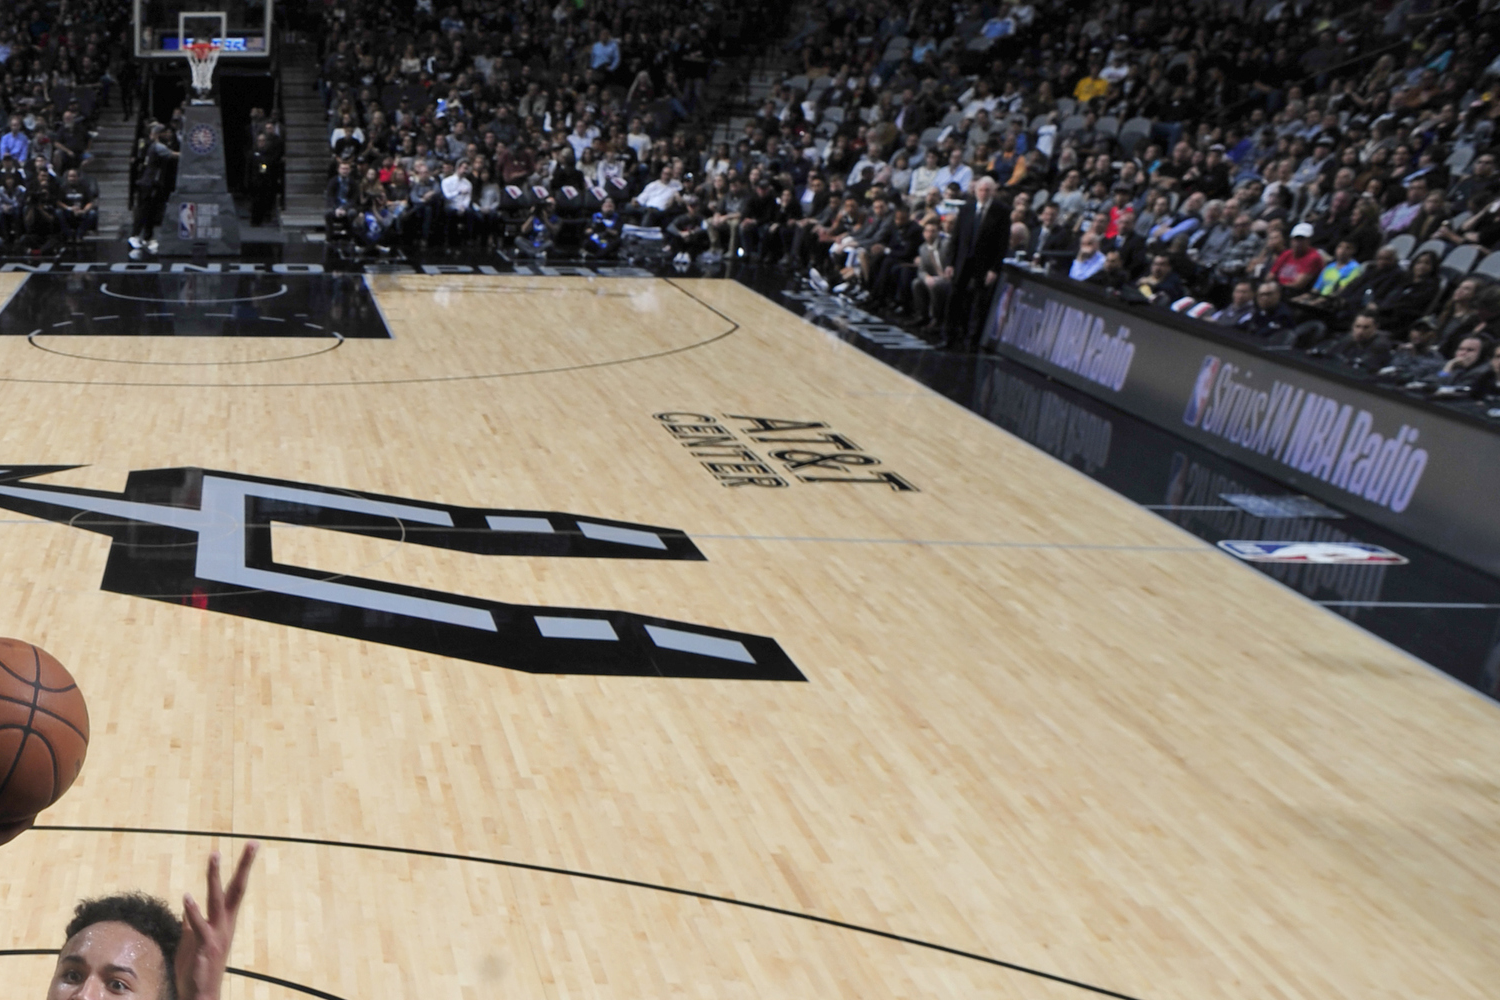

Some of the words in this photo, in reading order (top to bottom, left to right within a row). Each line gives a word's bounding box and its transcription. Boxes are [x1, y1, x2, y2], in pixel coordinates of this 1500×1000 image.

[1079, 316, 1136, 392] Radio
[652, 411, 789, 488] CENTER
[722, 412, 921, 492] AT&T
[1201, 361, 1305, 461] SiriusXM
[1282, 391, 1354, 482] NBA
[1331, 409, 1429, 514] Radio
